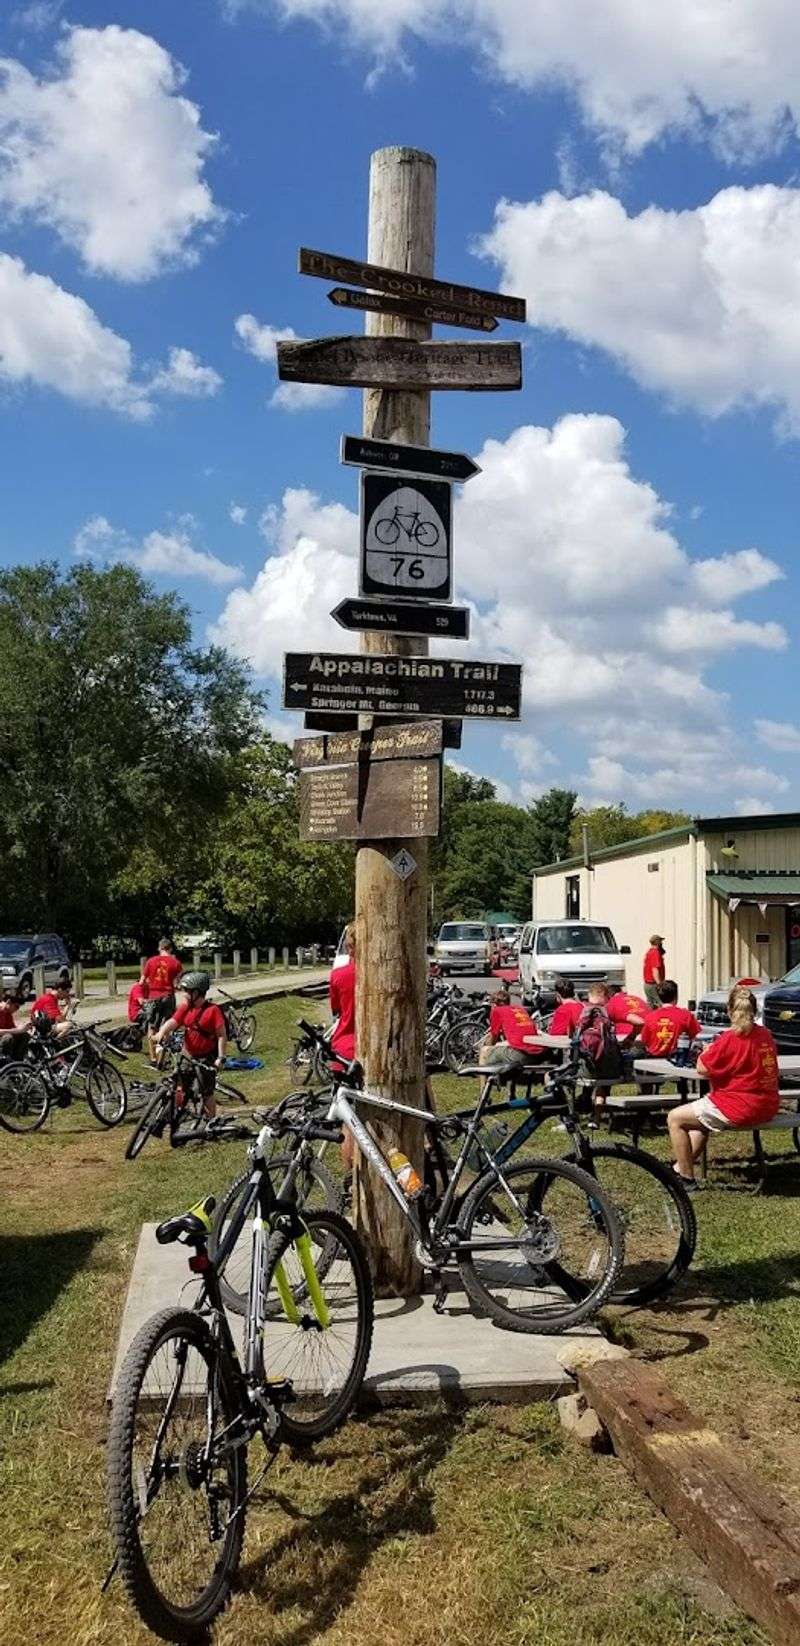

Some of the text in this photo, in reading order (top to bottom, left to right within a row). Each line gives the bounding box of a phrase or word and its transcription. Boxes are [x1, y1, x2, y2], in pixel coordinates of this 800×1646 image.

[307, 255, 350, 279] The
[361, 269, 454, 302] Crooked
[424, 307, 457, 323] Carter
[389, 558, 425, 580] 76
[309, 655, 500, 681] Appalachian Trail
[311, 696, 357, 712] Springer
[379, 699, 420, 712] Georgia
[396, 729, 430, 748] Trail
